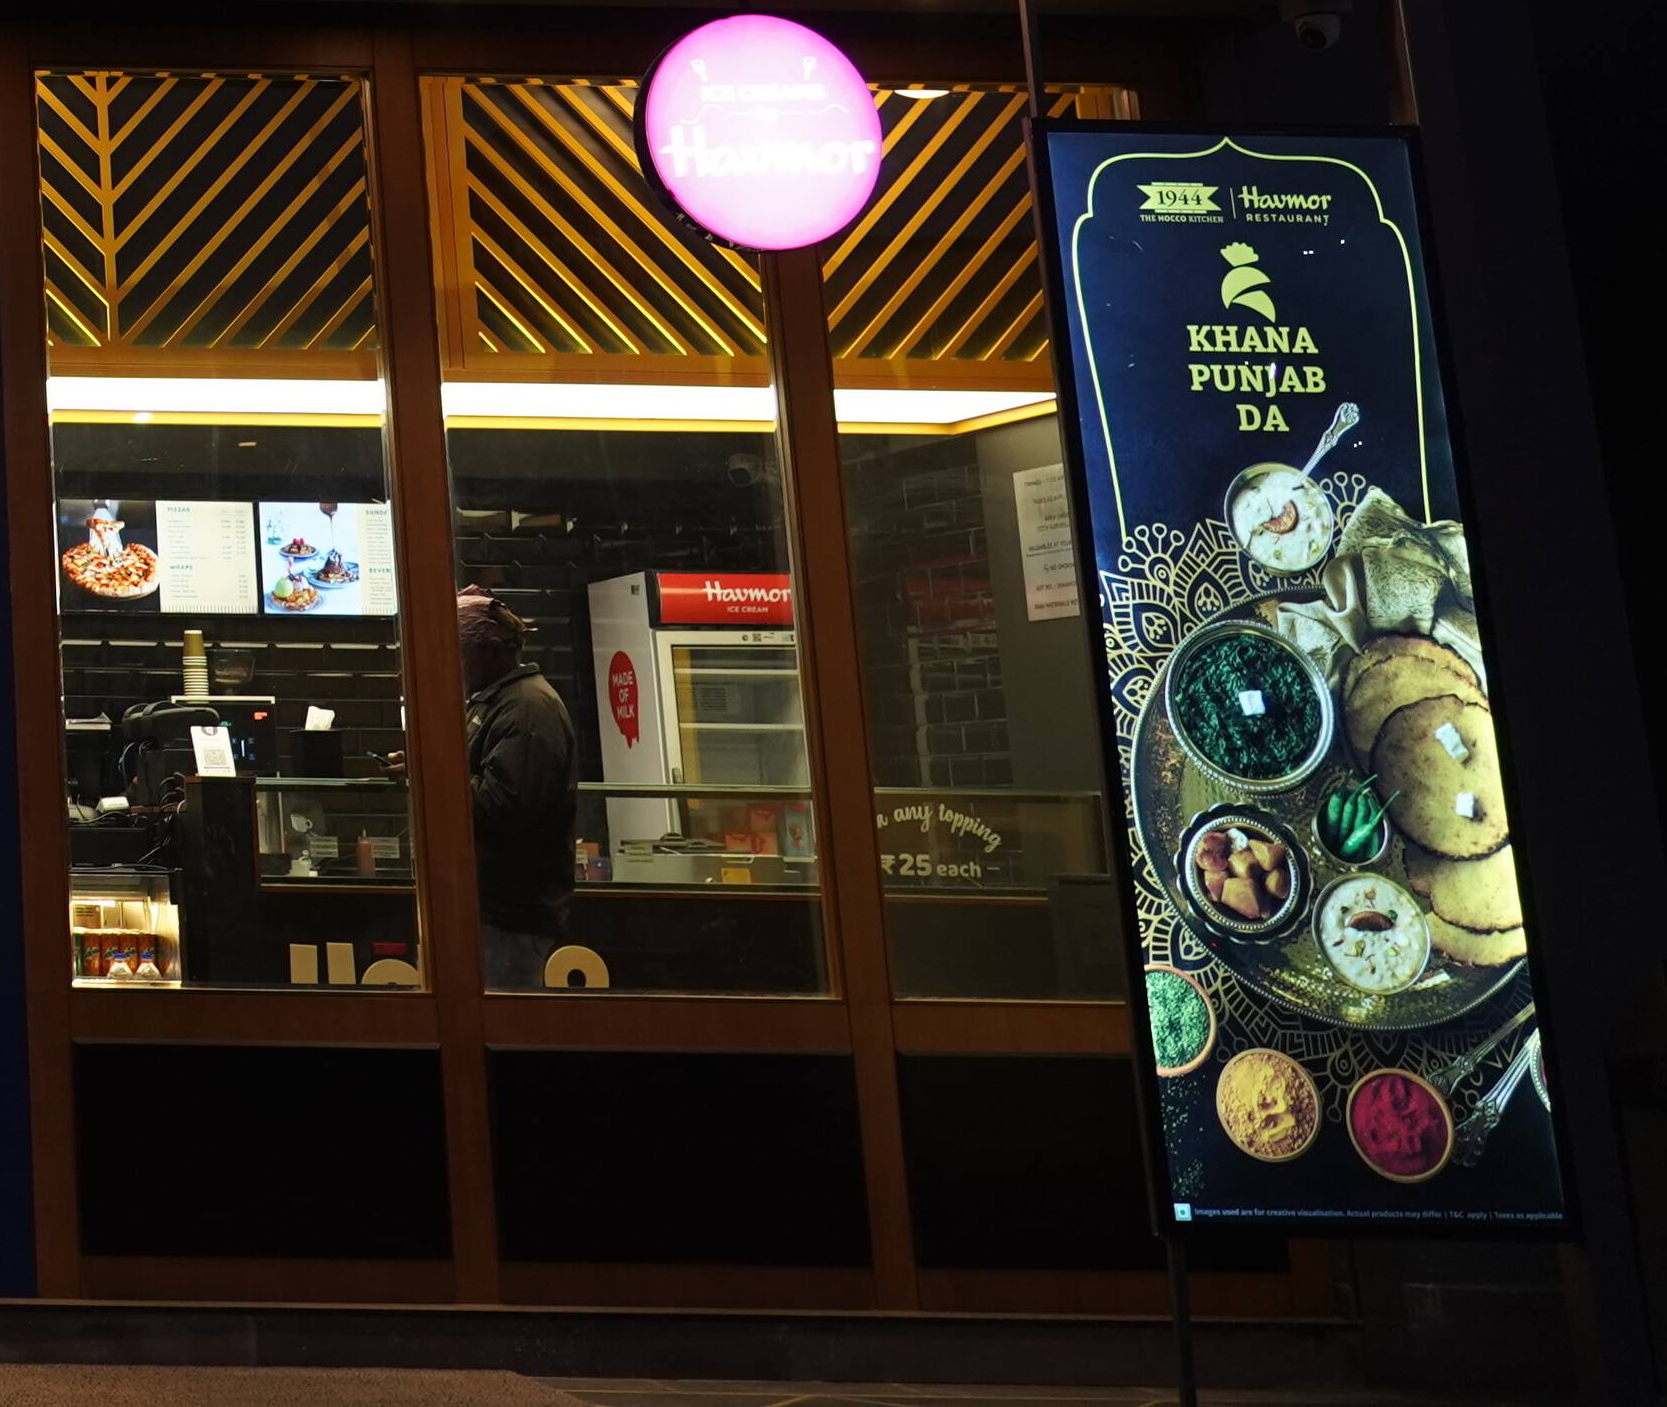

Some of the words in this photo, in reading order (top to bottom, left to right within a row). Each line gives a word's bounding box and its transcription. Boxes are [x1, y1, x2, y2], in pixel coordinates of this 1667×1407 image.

[659, 125, 876, 177] Havmor
[1156, 189, 1203, 207] 1944
[1238, 185, 1332, 210] Havmor
[1140, 214, 1156, 222] THE
[1158, 215, 1186, 223] HOCCO
[1188, 215, 1224, 223] KITCHEN
[1245, 213, 1330, 223] RESTAURANT
[1186, 324, 1319, 354] KHANA
[1188, 363, 1327, 397] PUNJAB
[1236, 403, 1290, 432] DA
[701, 580, 791, 603] Havmor
[612, 671, 634, 687] MADE
[618, 688, 629, 704] OF
[616, 706, 635, 720] MILK
[893, 802, 934, 833] any
[938, 802, 1003, 853] topping
[936, 861, 982, 878] each
[1222, 1209, 1239, 1217] used
[1254, 1209, 1265, 1217] for
